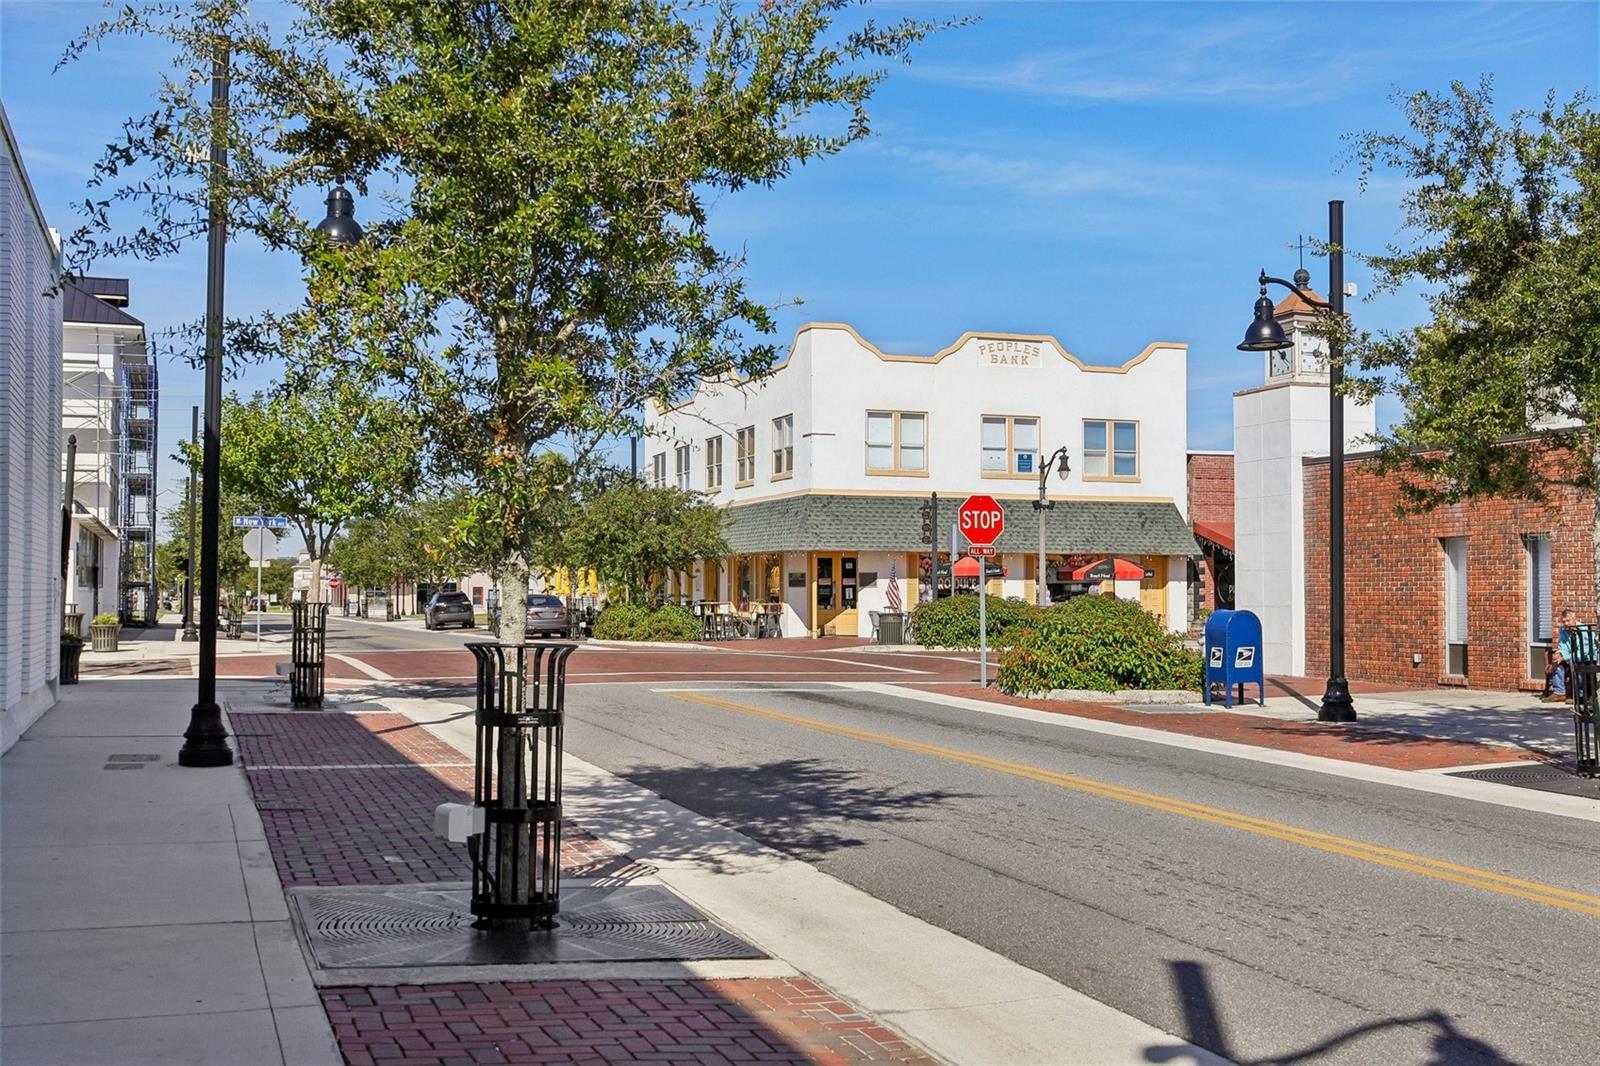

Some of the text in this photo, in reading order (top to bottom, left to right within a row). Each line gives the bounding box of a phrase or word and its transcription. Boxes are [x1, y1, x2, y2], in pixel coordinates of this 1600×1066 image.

[978, 342, 1041, 357] PEOPLES
[990, 354, 1030, 365] BANK
[244, 518, 258, 526] New
[962, 510, 1001, 529] STOP
[970, 548, 981, 556] ALL
